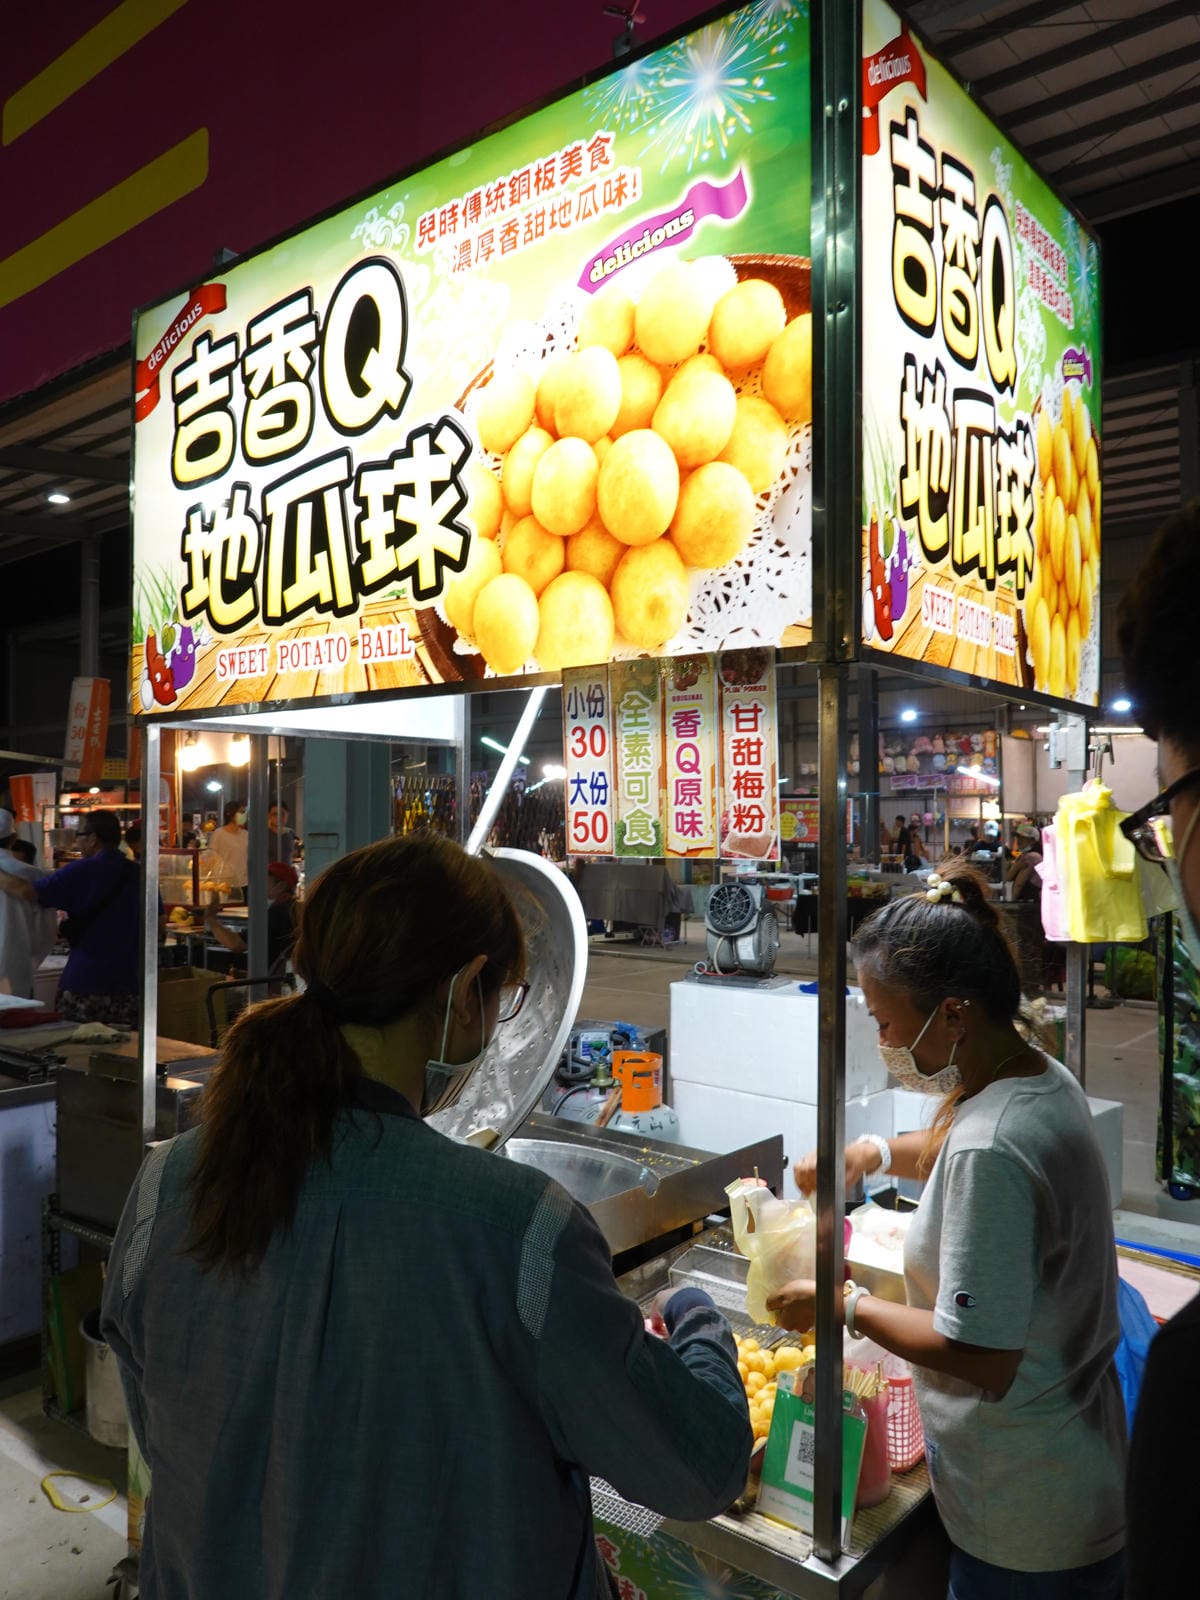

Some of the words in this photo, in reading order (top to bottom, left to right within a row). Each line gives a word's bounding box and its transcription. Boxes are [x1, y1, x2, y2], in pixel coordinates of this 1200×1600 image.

[868, 54, 912, 87] delicious
[417, 133, 613, 249] 兒時傳統銅板美食
[452, 172, 638, 273] 濃厚香甜地瓜味!
[589, 208, 695, 284] delicious
[890, 105, 1017, 397] 吉香Q
[146, 301, 204, 372] delicious
[172, 256, 412, 489] 吉香Q
[181, 416, 474, 633] 地瓜球
[900, 352, 1036, 601] 地瓜球
[218, 650, 268, 678] SWEET
[279, 637, 348, 669] POTATO
[360, 627, 413, 659] BALL
[567, 683, 606, 720] 小份
[570, 771, 609, 806] 大份
[571, 725, 606, 758] 30
[620, 694, 653, 844] 全素可食
[671, 708, 704, 838] 香Q原味
[731, 703, 766, 834] 甘甜梅粉
[572, 811, 609, 843] 50
